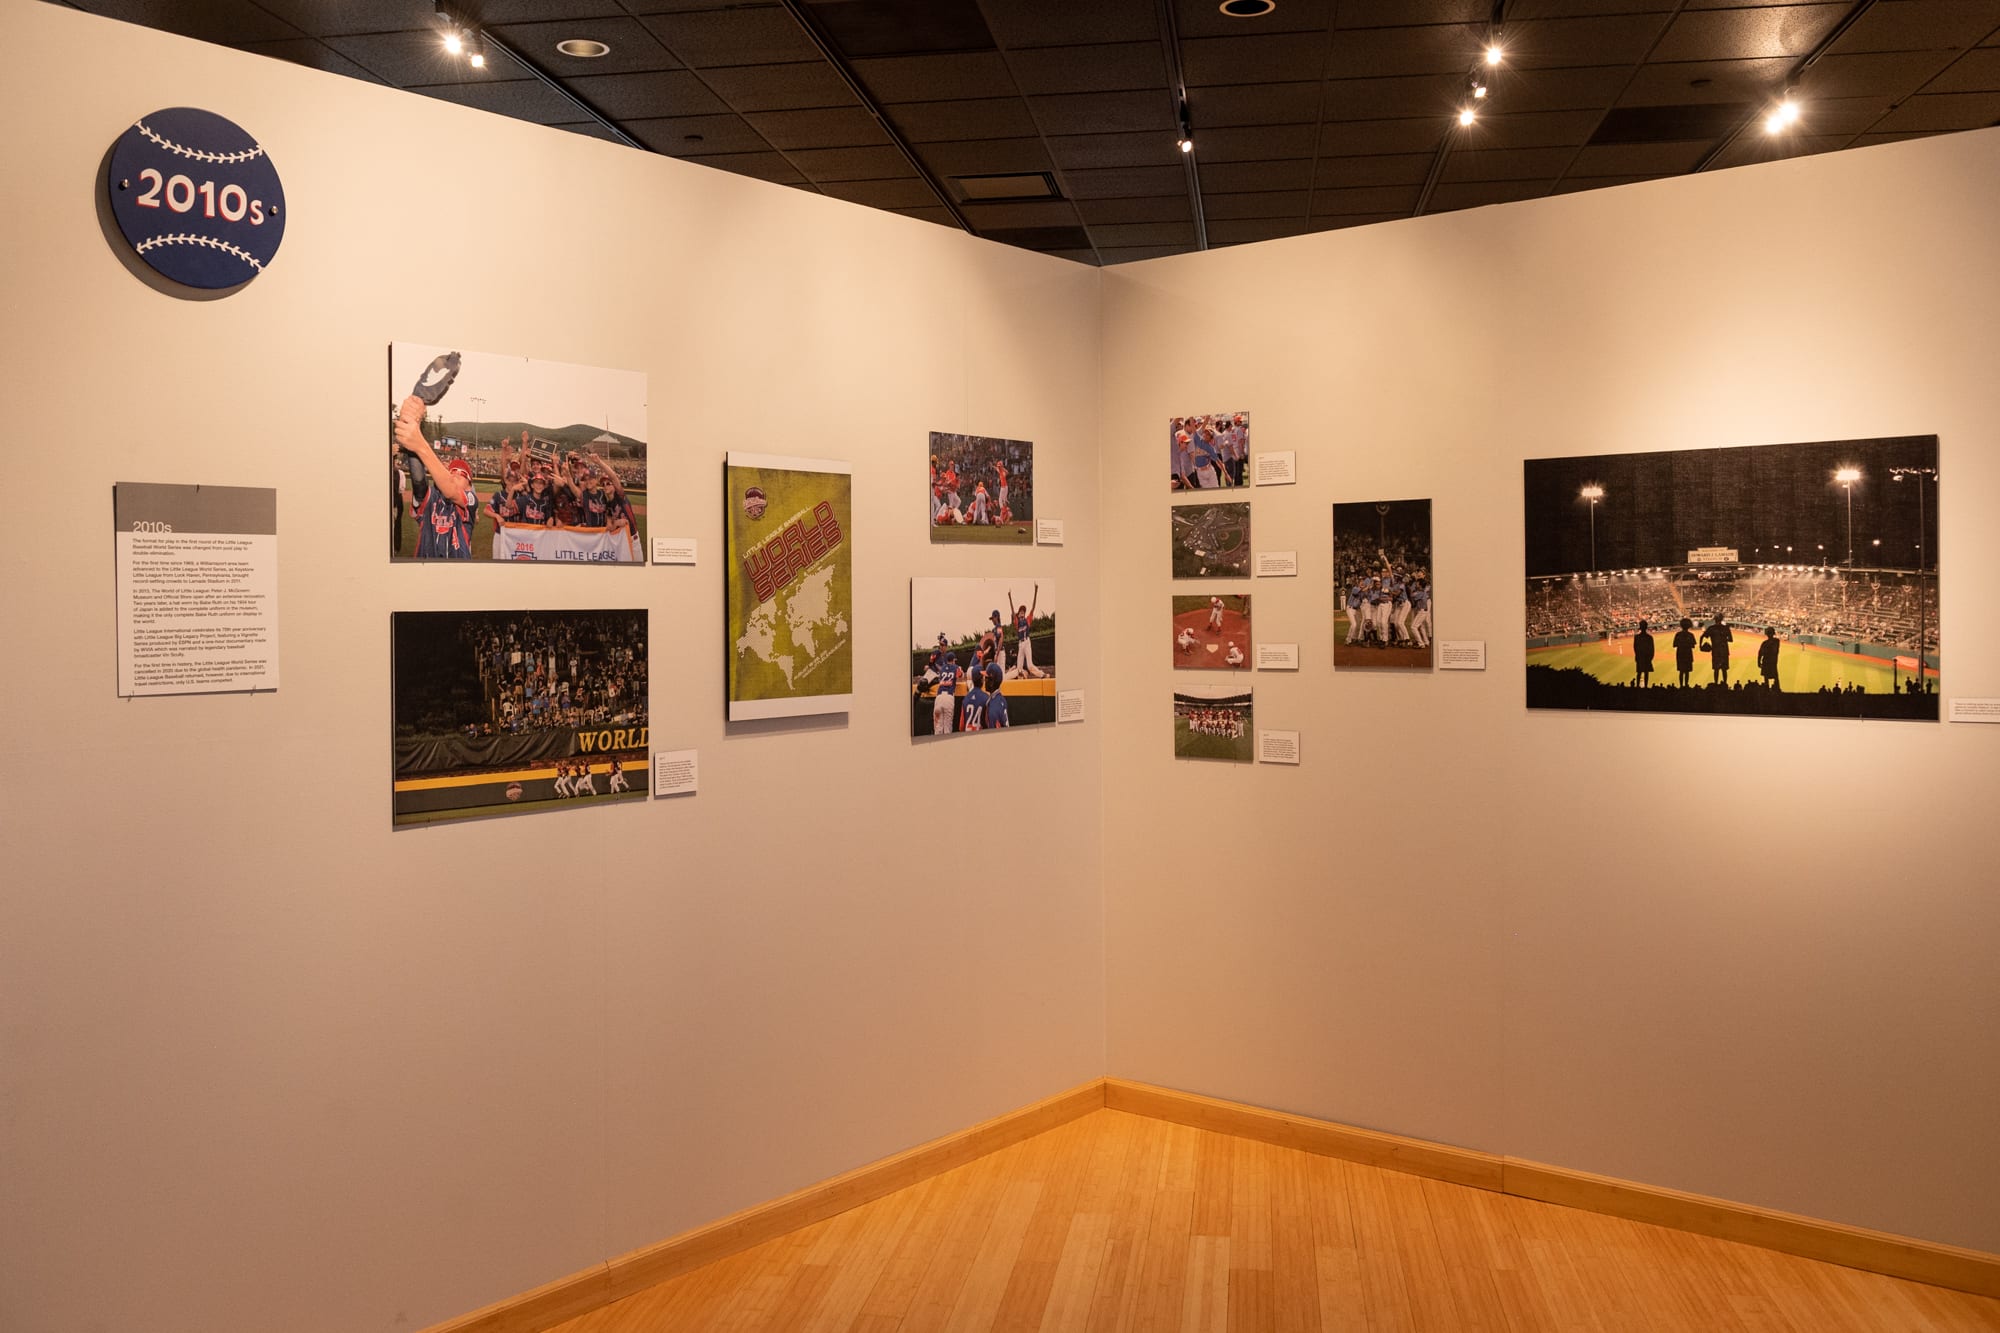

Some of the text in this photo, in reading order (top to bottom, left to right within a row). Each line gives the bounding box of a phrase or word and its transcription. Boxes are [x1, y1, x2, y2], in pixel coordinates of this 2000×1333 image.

[136, 168, 265, 226] 2010s
[133, 520, 172, 533] 2010s
[516, 542, 534, 552] 2016
[744, 501, 835, 581] WORLD
[555, 550, 584, 560] LITTLE
[754, 520, 844, 604] SERIES
[941, 672, 954, 682] 22
[965, 704, 982, 732] 24
[578, 727, 649, 752] WORLD
